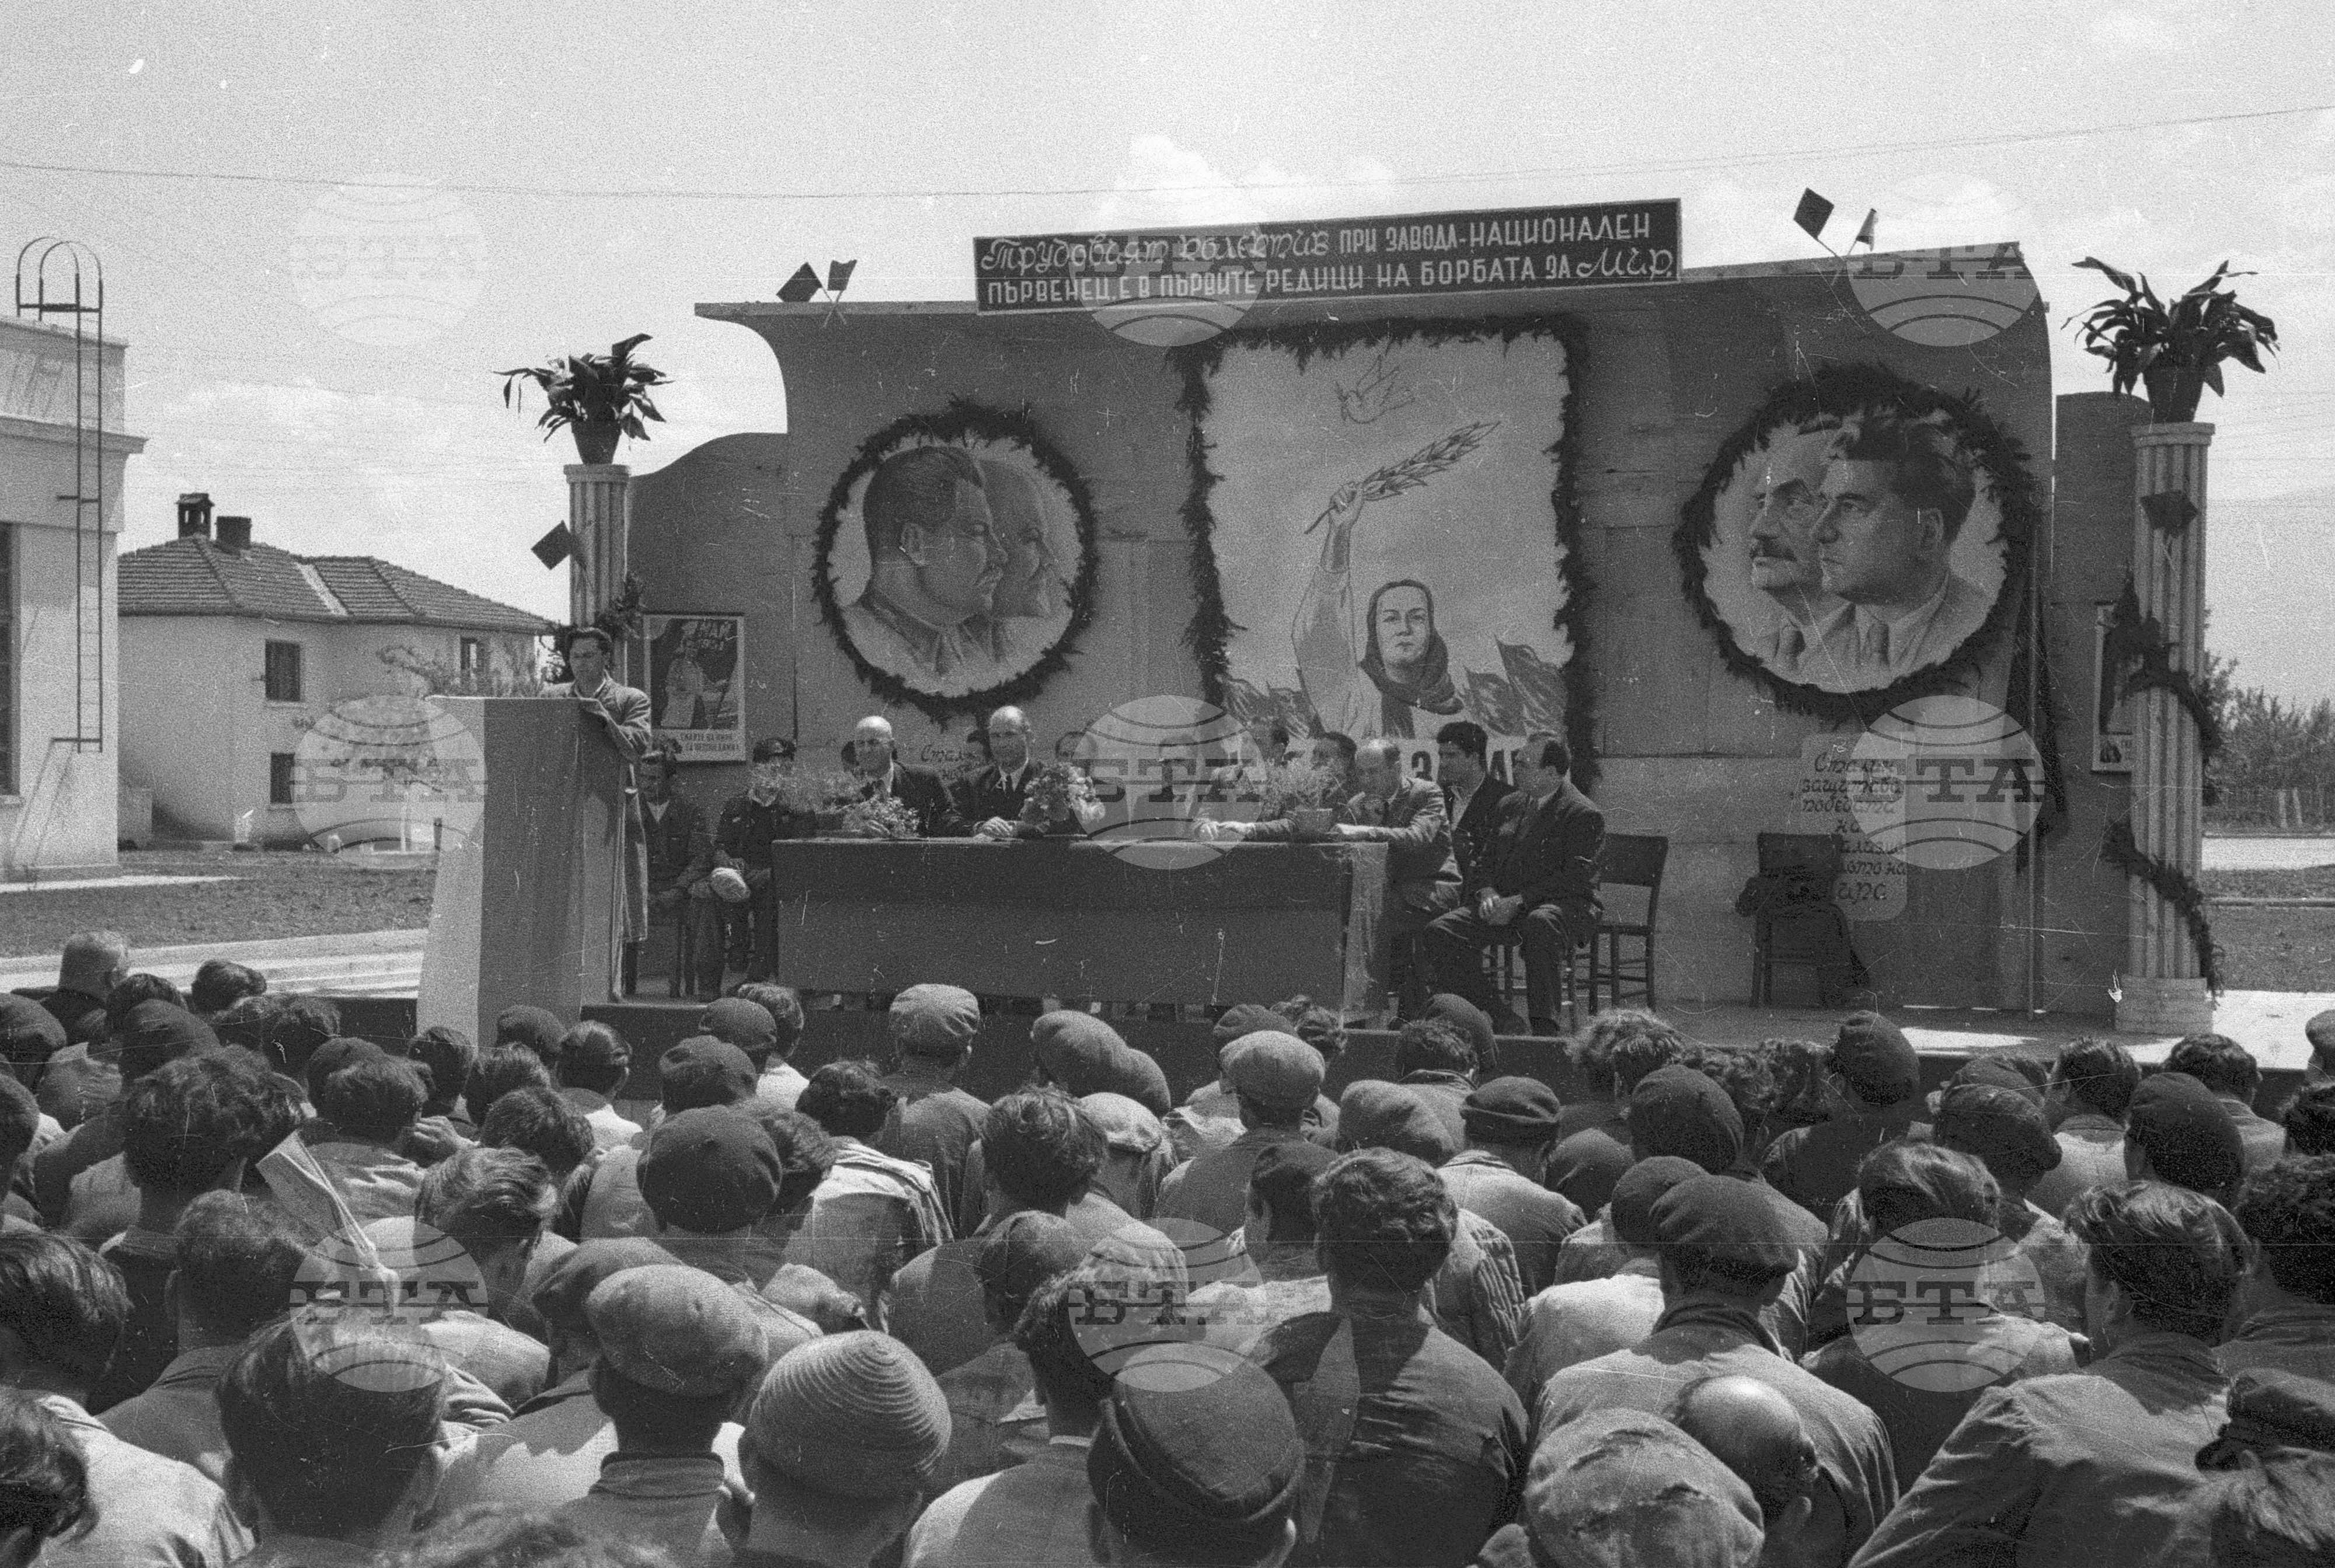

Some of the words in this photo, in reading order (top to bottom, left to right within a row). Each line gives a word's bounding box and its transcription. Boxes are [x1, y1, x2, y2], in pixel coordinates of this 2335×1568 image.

[1342, 227, 1377, 253] ПРИ
[1138, 275, 1151, 298] В
[1159, 270, 1257, 297] ПЪРВИТЕ
[1266, 264, 1363, 293] РЕДИЦИ
[1378, 263, 1410, 287] НА
[1420, 256, 1536, 285] БОРБАТА
[1545, 253, 1571, 280] ЗА
